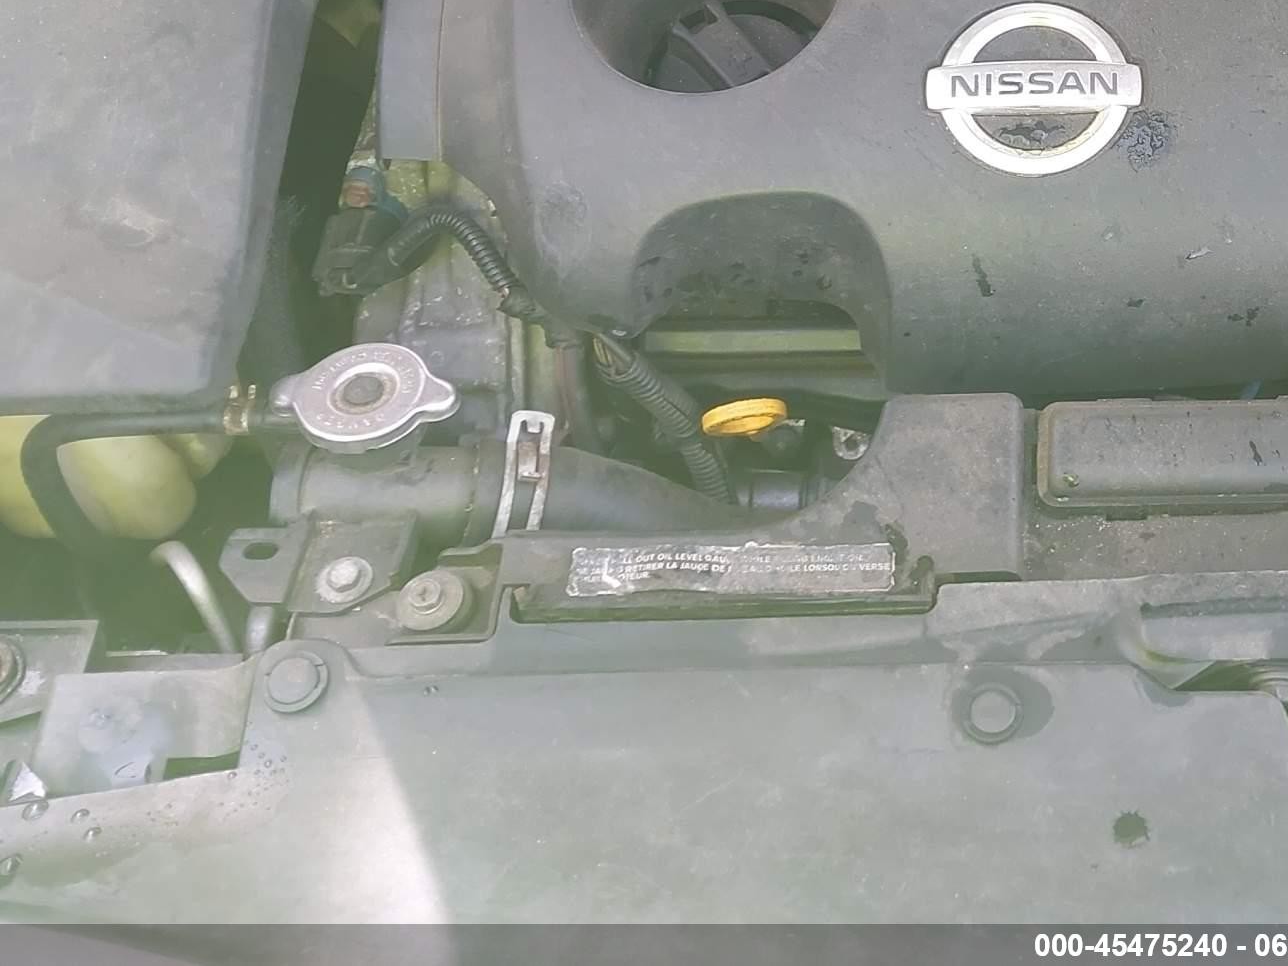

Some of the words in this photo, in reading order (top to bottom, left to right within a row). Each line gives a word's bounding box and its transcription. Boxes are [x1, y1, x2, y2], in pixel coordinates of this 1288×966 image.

[950, 71, 1119, 99] NISSAN
[635, 552, 655, 563] OUT
[657, 552, 673, 562] OIL
[675, 552, 703, 562] LEVEL
[666, 560, 678, 570] LA
[711, 563, 726, 573] DE
[858, 562, 892, 571] VERSE
